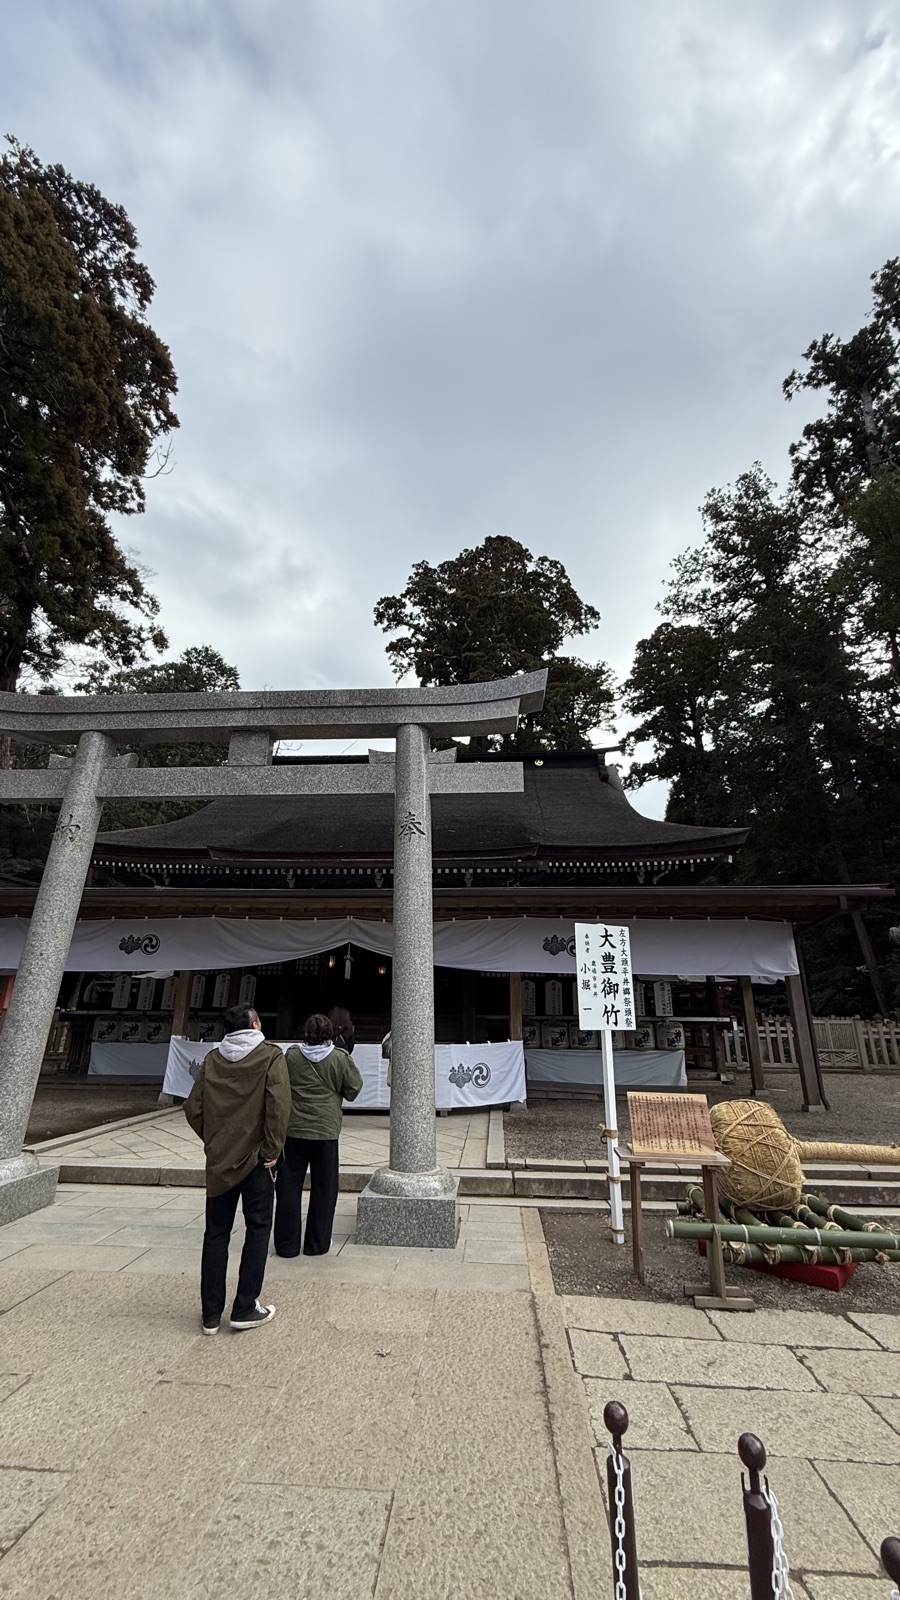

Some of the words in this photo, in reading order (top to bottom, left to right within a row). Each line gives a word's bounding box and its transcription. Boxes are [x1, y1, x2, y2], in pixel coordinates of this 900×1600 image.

[397, 811, 426, 843] 奉
[598, 927, 621, 1027] 大豊御竹
